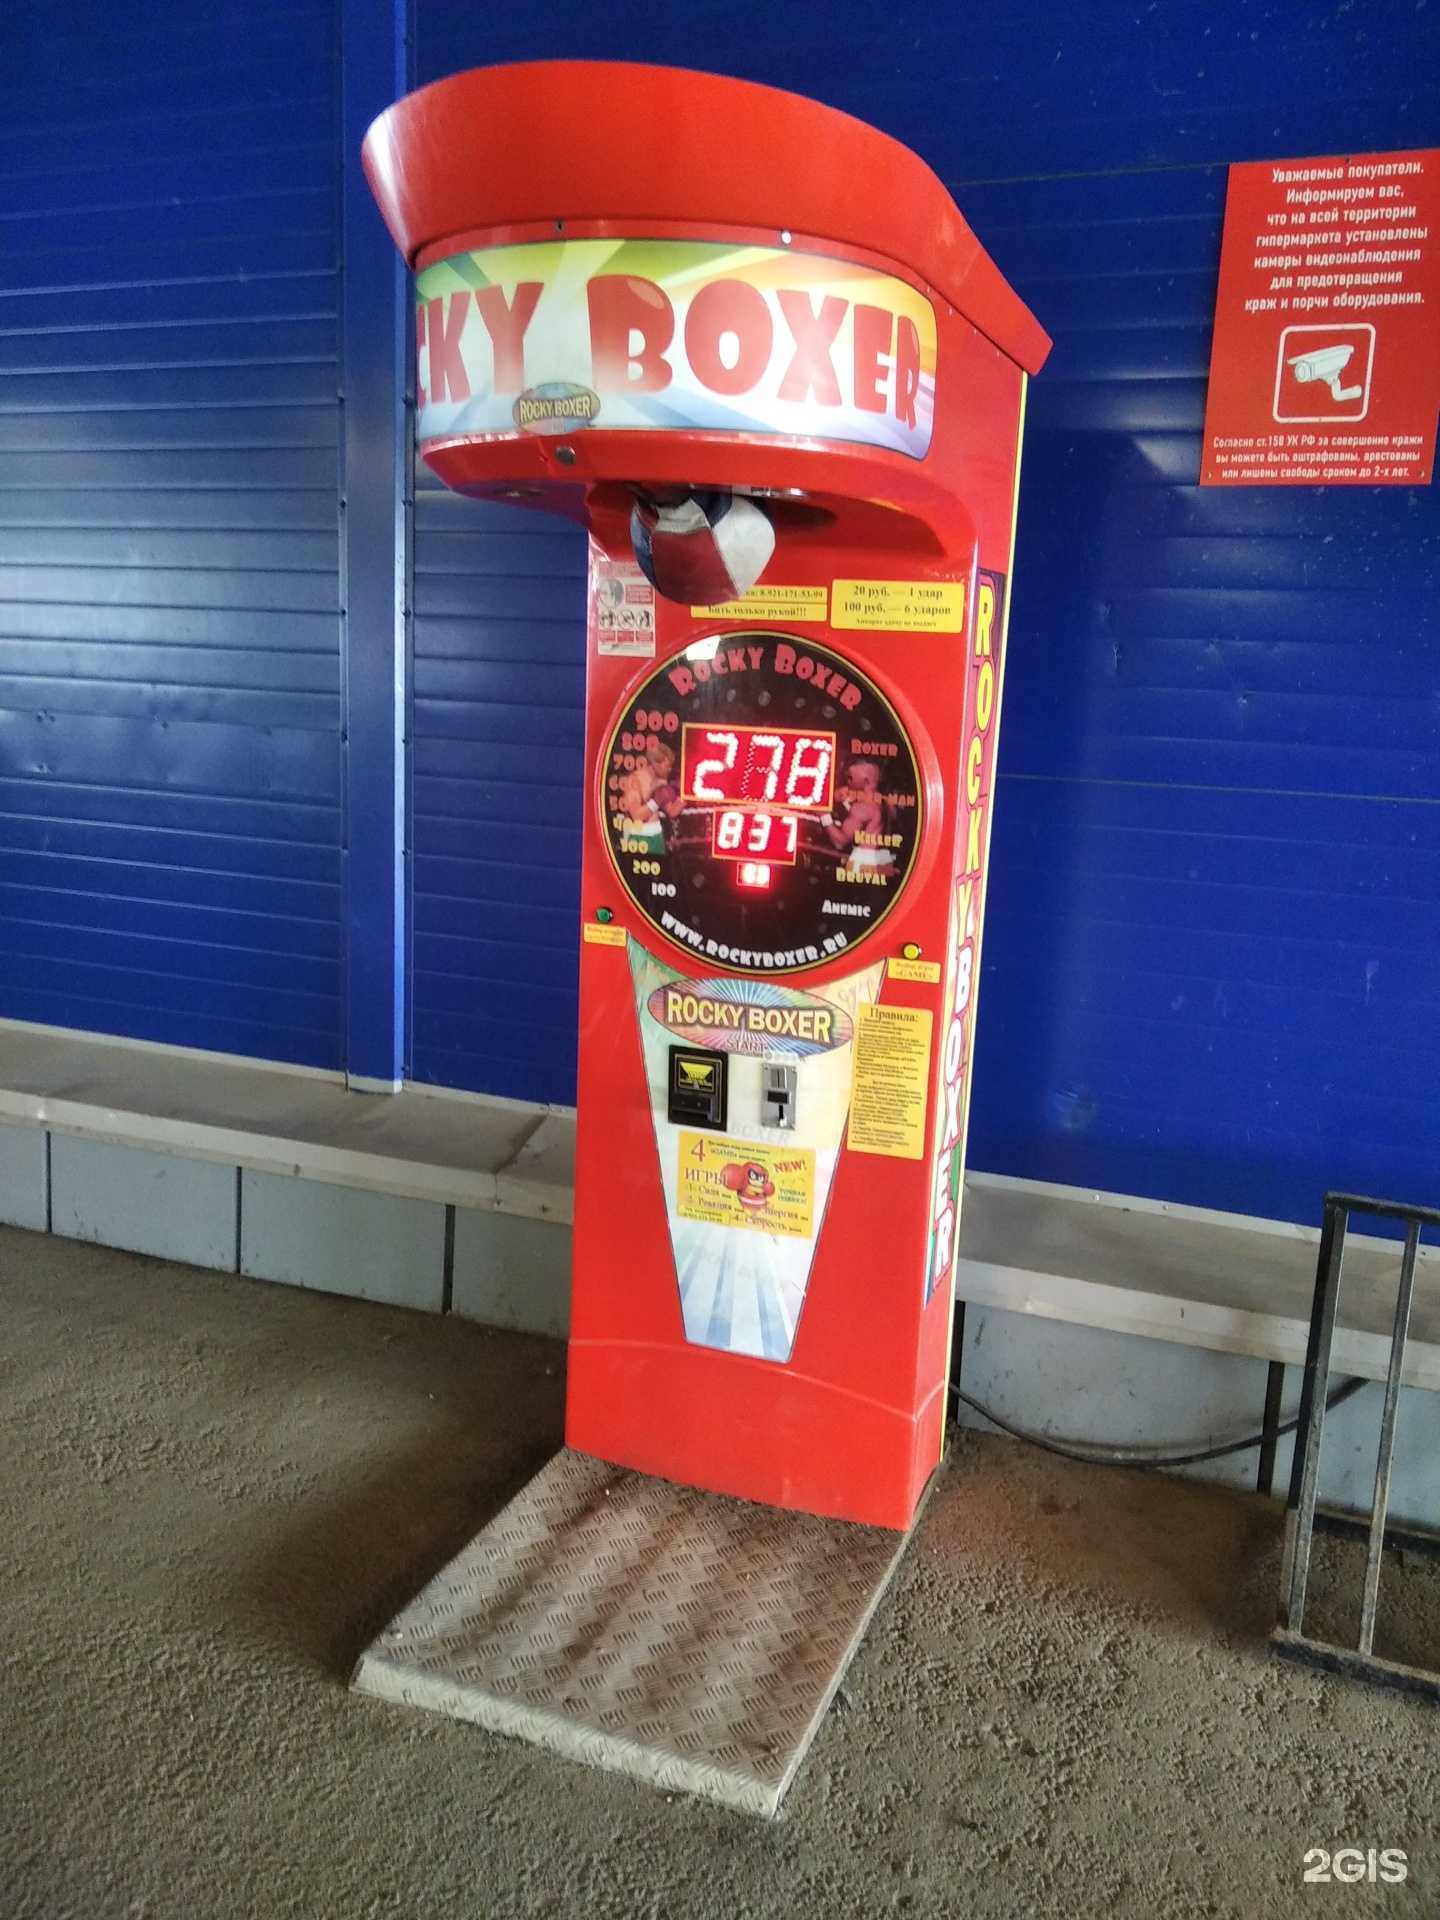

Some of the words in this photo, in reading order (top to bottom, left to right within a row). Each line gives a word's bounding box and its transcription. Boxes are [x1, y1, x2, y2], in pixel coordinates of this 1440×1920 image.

[1272, 167, 1344, 183] Уважаемые
[1286, 186, 1374, 206] Информируем
[1267, 213, 1287, 226] что
[1291, 213, 1305, 225] на
[1309, 207, 1339, 223] всей
[1343, 205, 1417, 224] территории
[1256, 232, 1341, 250] гипермаркета
[1346, 226, 1428, 246] установлены
[1254, 254, 1301, 270] камеры
[1305, 249, 1421, 267] видеонаблюдения
[1269, 276, 1293, 290] для
[1296, 271, 1403, 290] предотвращения
[1244, 297, 1277, 314] краж
[1280, 297, 1288, 309] и
[1292, 295, 1329, 312] порчи
[1332, 291, 1425, 310] оборудования.
[417, 280, 544, 407] KY
[587, 274, 921, 432] BOXER
[520, 400, 553, 423] ROCKY
[554, 395, 591, 418] BOXER
[1213, 437, 1253, 449] Согласно
[1287, 436, 1298, 447] УК
[1301, 436, 1315, 447] РФ
[1318, 437, 1329, 446] за
[1331, 436, 1389, 448] совершение
[1392, 436, 1424, 447] кражи
[1216, 454, 1228, 463] вы
[1231, 453, 1265, 463] можете
[1267, 451, 1290, 463] быть
[1363, 451, 1420, 463] арестованы
[1222, 469, 1238, 478] или
[1241, 468, 1278, 478] лишены
[1280, 465, 1320, 478] свободы
[1322, 467, 1357, 480] сроком
[1359, 467, 1372, 478] до
[1374, 465, 1390, 477] 2-х
[853, 585, 866, 597] 20
[918, 589, 943, 600] удар
[844, 602, 861, 613] 100
[635, 709, 679, 733] 900
[622, 732, 659, 751] 800
[613, 753, 649, 771] 700
[692, 732, 832, 806] 278
[957, 584, 994, 940] ROCKY
[716, 811, 798, 853] 837
[632, 859, 661, 876] 200
[651, 882, 677, 898] 100
[668, 991, 745, 1027] ROCKY
[749, 1008, 831, 1043] BOXER
[870, 1007, 919, 1023] Правила:
[934, 946, 973, 1278] BOXER
[691, 1138, 706, 1163] 4
[685, 1167, 727, 1185] ИГРЫ
[774, 1159, 807, 1174] NEW!
